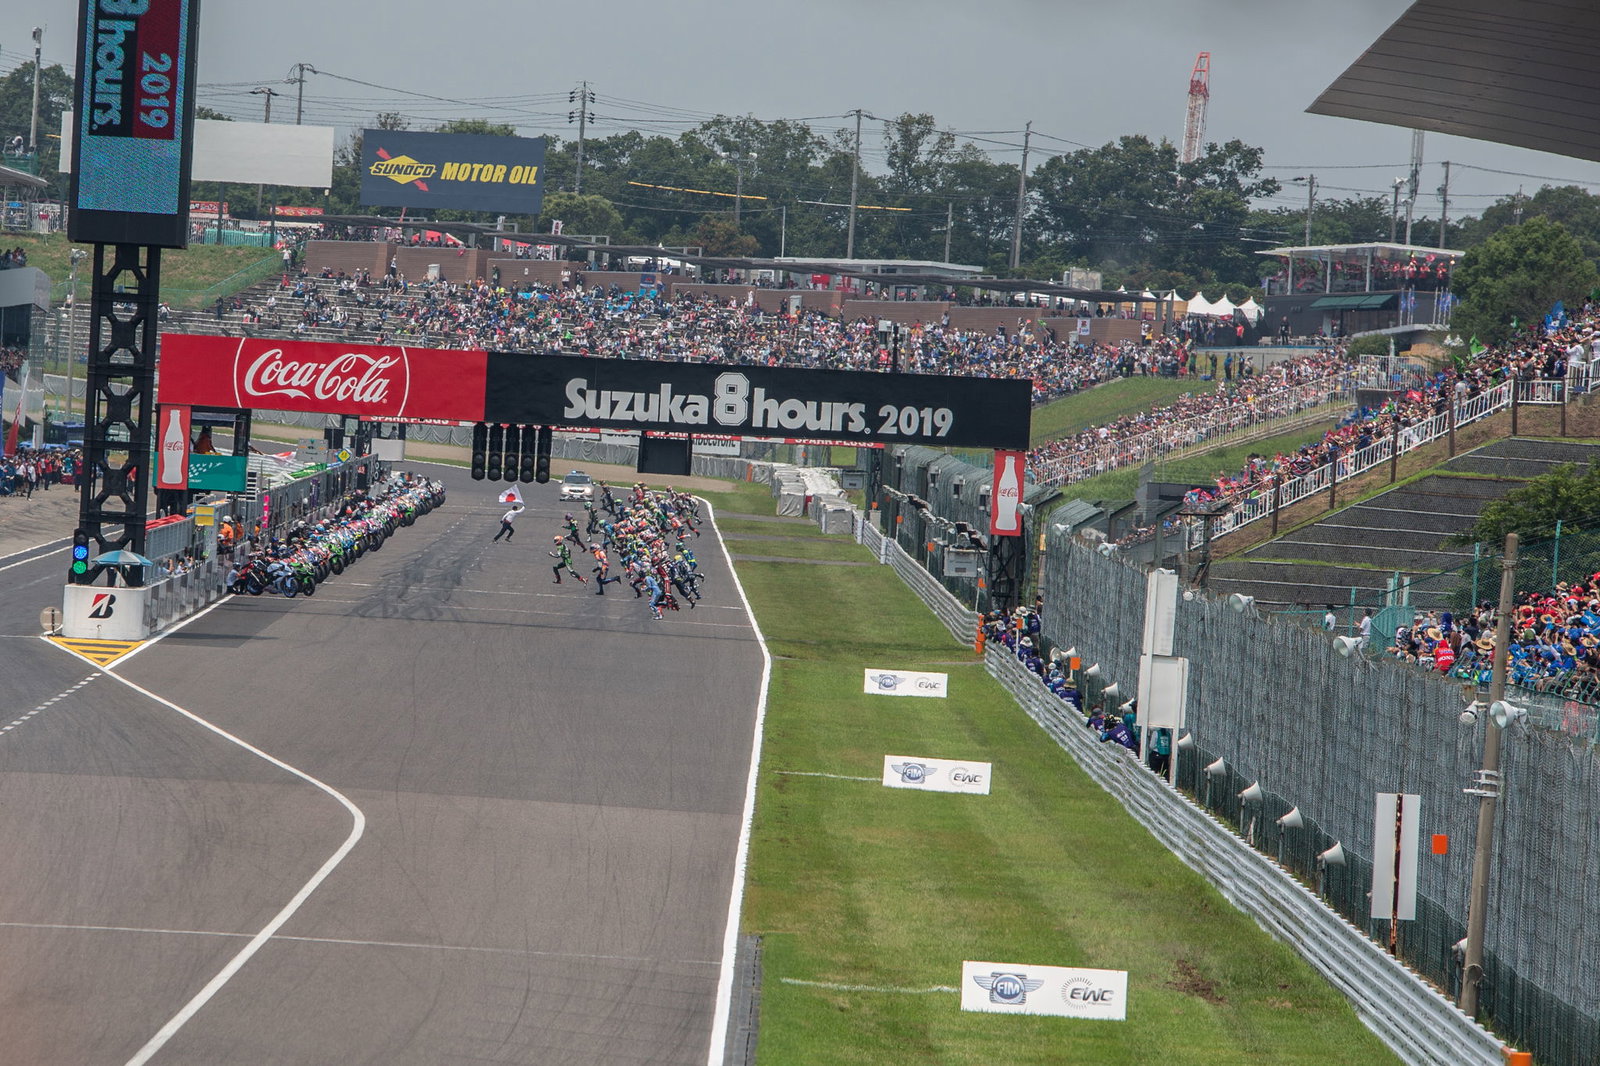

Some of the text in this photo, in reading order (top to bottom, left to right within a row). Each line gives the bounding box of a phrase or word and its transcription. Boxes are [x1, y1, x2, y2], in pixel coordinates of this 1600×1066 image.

[140, 51, 172, 128] 2019
[372, 162, 538, 185] SUNOCO MOTOR OIL
[245, 349, 400, 404] Coca-Cola
[564, 377, 708, 424] Suzuka
[713, 372, 750, 426] 8
[877, 404, 954, 437] 2019
[918, 681, 941, 689] EWC
[906, 768, 922, 777] FIM
[953, 773, 983, 783] EWC
[997, 981, 1020, 995] FIM
[1070, 986, 1114, 1002] EWC
